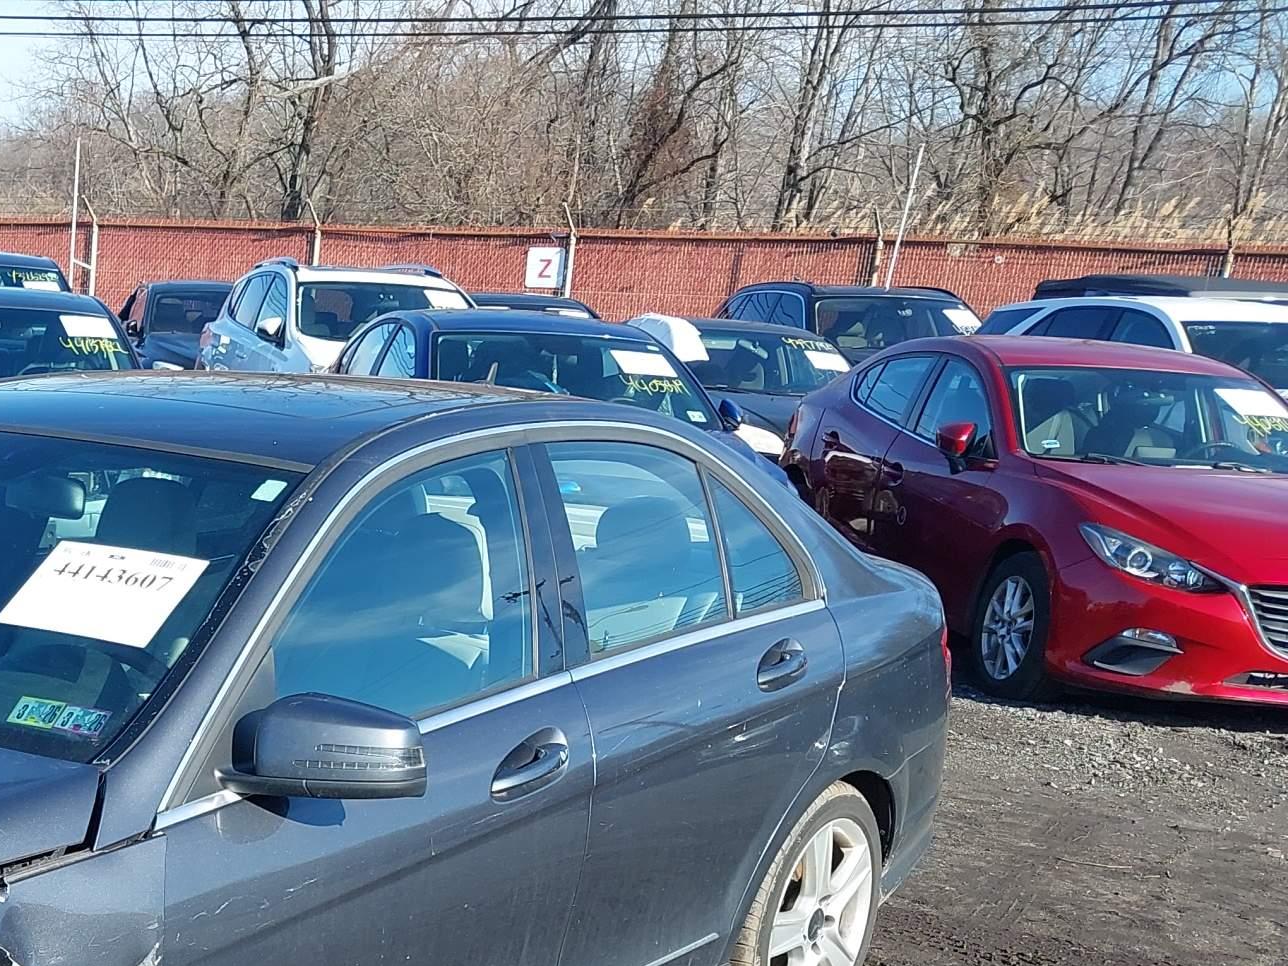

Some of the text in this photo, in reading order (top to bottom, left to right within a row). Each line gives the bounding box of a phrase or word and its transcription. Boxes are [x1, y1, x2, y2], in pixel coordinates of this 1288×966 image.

[538, 258, 553, 278] Z
[53, 561, 174, 592] 44143607
[15, 703, 63, 724] 3 26
[60, 711, 108, 732] 3 26
